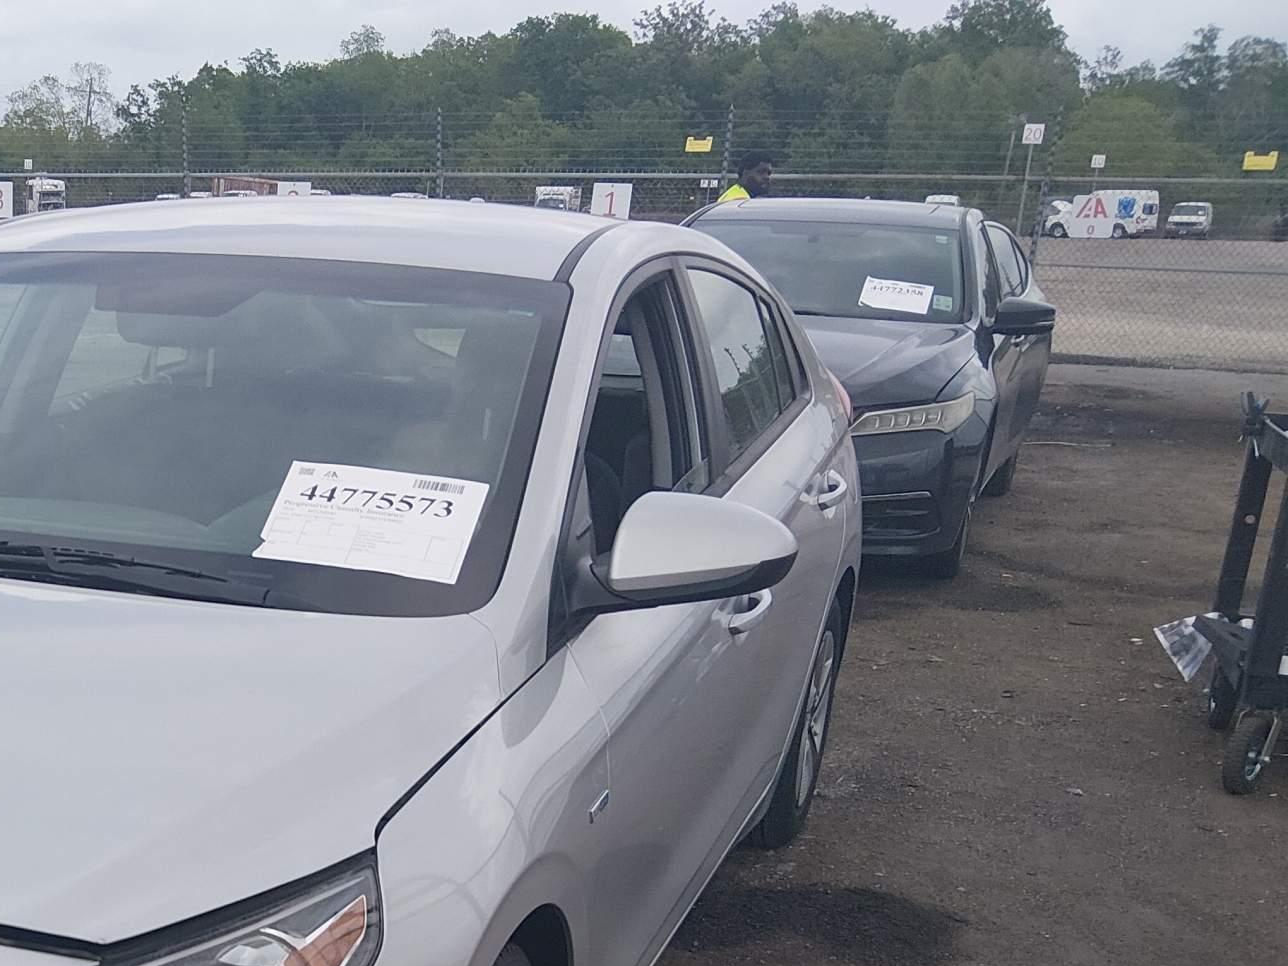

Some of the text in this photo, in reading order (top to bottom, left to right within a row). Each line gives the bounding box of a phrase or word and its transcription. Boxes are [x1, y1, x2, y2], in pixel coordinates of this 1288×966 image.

[1024, 127, 1042, 141] 20
[603, 191, 617, 217] 1
[300, 484, 455, 518] 44775573
